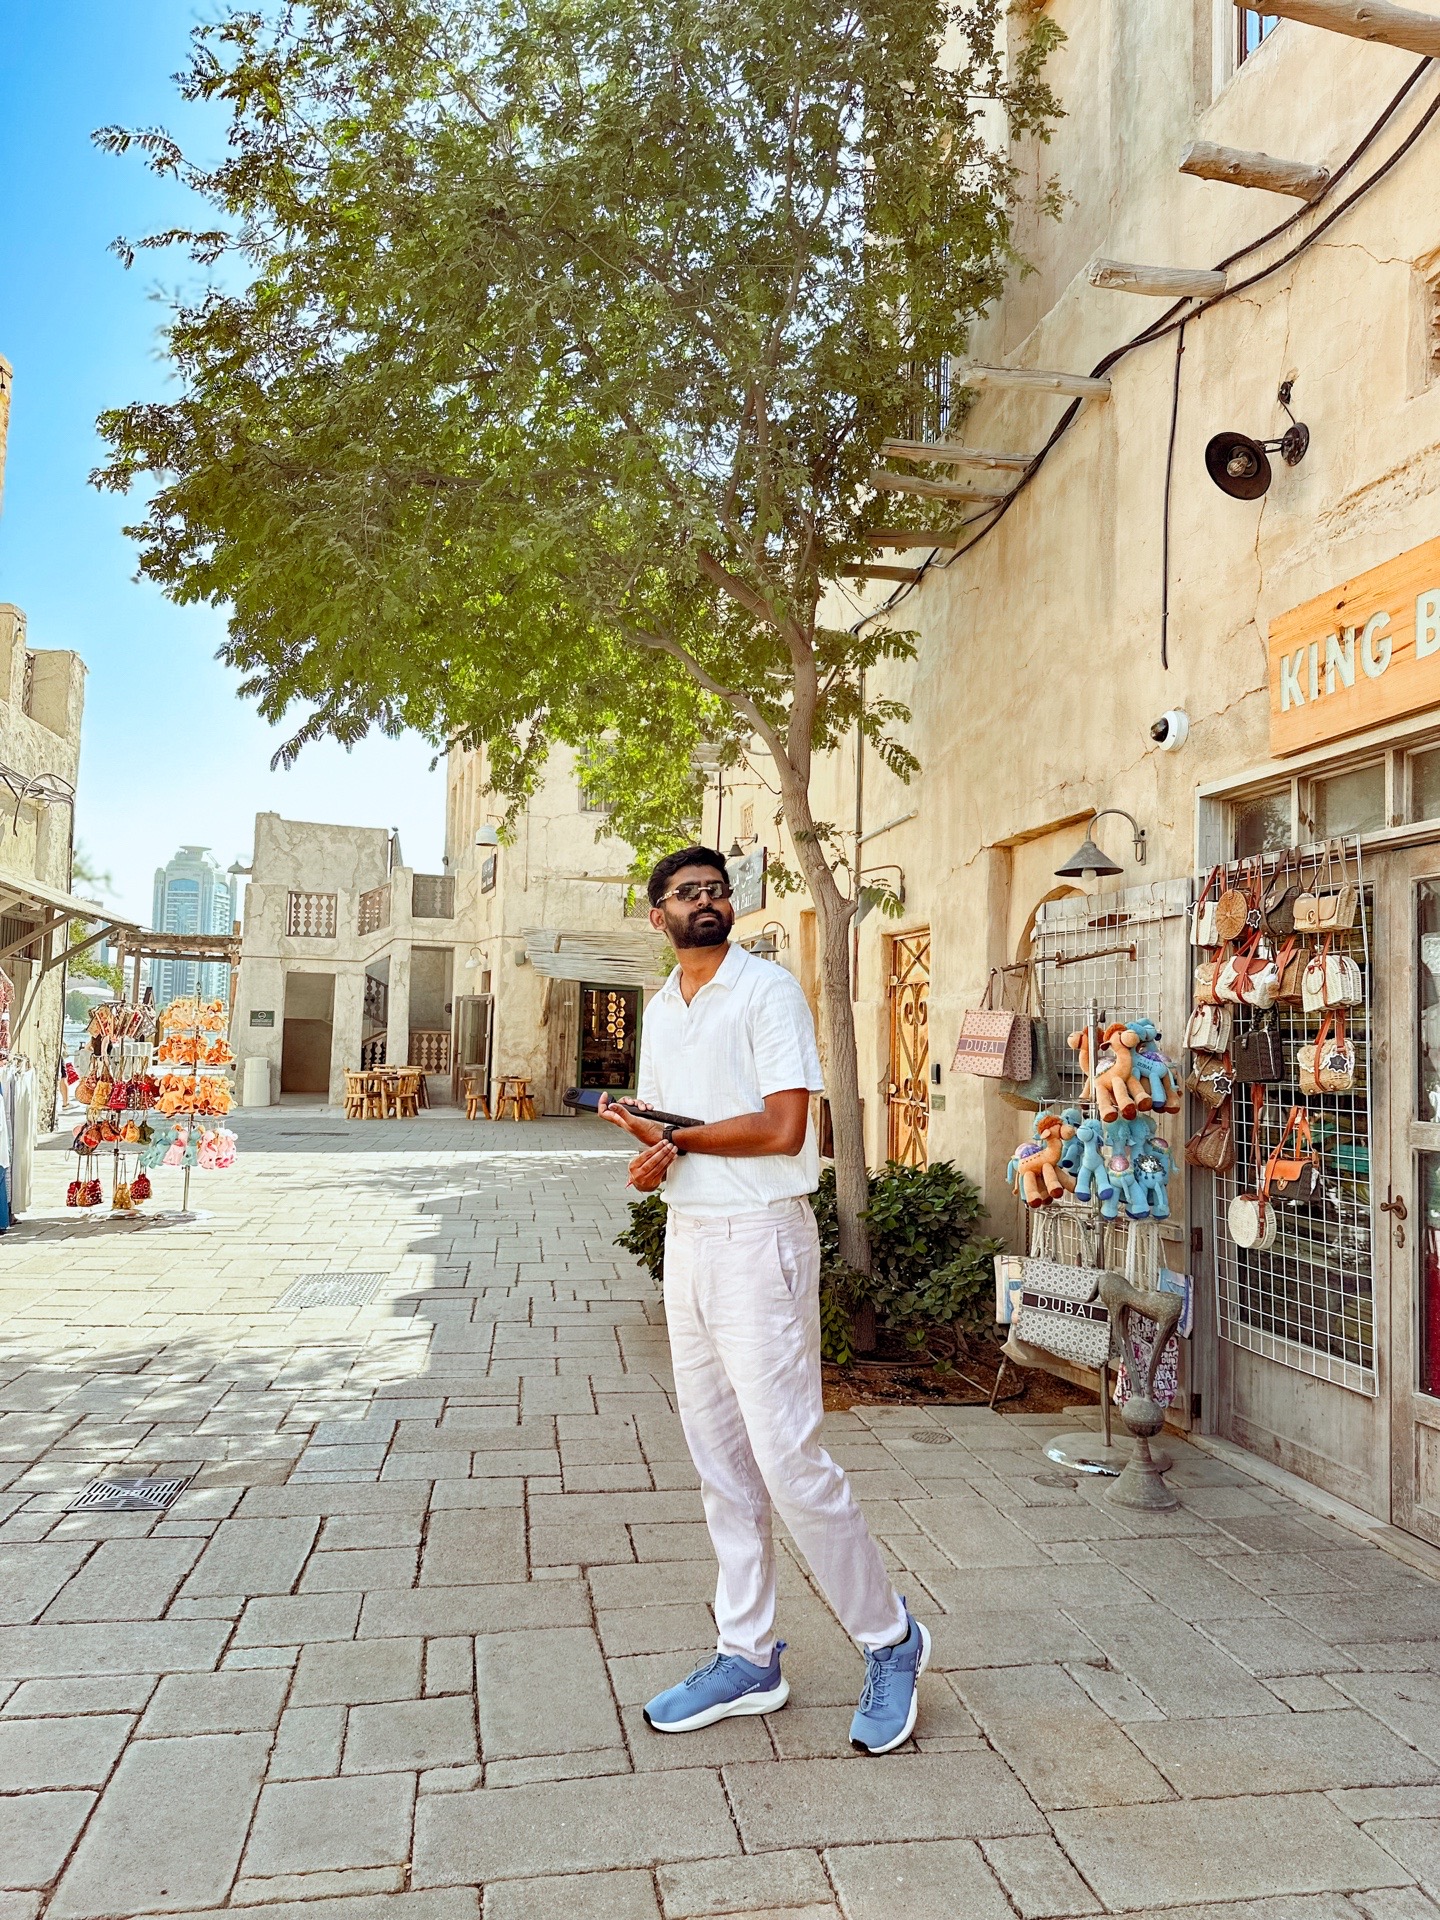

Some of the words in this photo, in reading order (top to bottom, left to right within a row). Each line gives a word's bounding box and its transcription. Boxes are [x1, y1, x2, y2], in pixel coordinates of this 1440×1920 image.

[1280, 610, 1393, 713] KING
[965, 1040, 998, 1053] DUBAI
[1137, 1062, 1153, 1071] DUBAI
[1037, 1296, 1093, 1319] DUBAI
